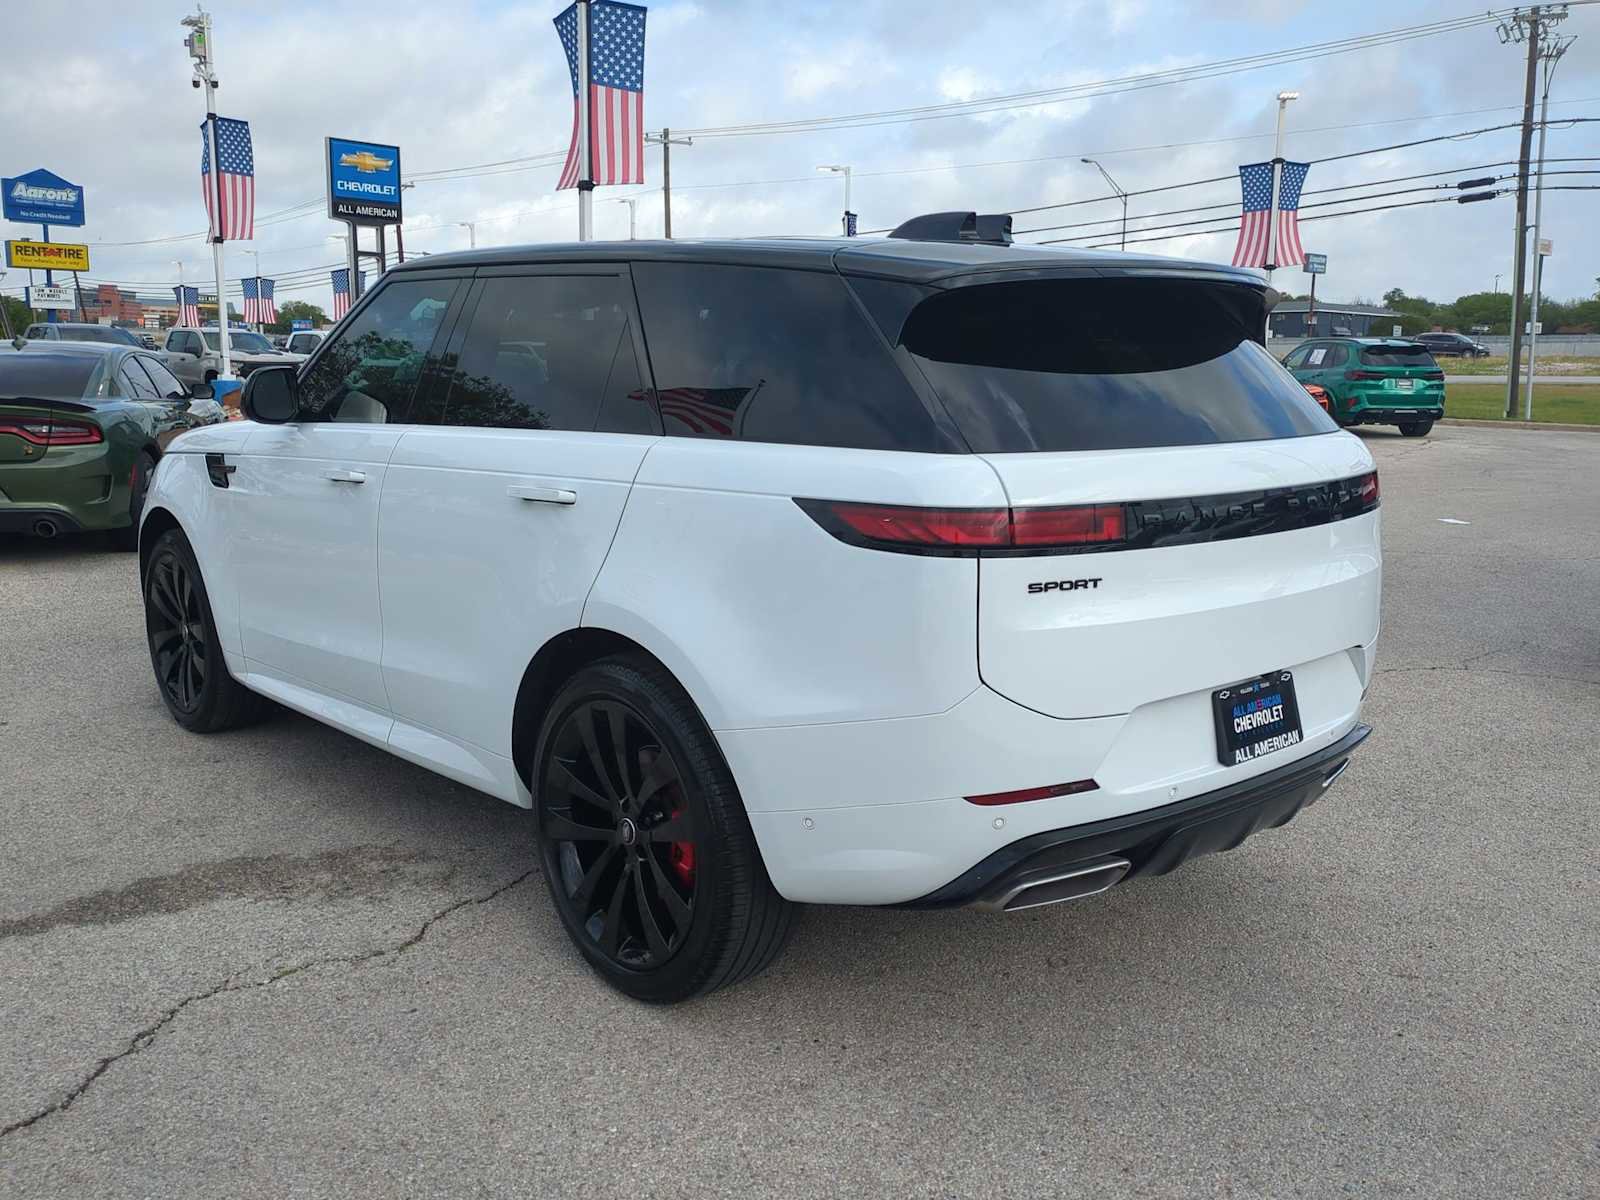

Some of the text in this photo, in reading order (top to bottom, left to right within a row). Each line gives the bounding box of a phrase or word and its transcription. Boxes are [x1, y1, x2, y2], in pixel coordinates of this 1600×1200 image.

[12, 181, 78, 202] Aaron's
[337, 180, 396, 196] CHEVROLET
[338, 204, 398, 218] ALL AMERICAN
[15, 245, 47, 257] RENT
[57, 247, 84, 260] TIRE
[1142, 503, 1265, 528] RANGE
[1028, 578, 1103, 594] SPORT
[1233, 694, 1281, 717] ALL AMERICAN
[1234, 705, 1283, 733] CHEVROLET
[1236, 747, 1253, 763] ALL
[1254, 730, 1299, 757] AMERICAN
